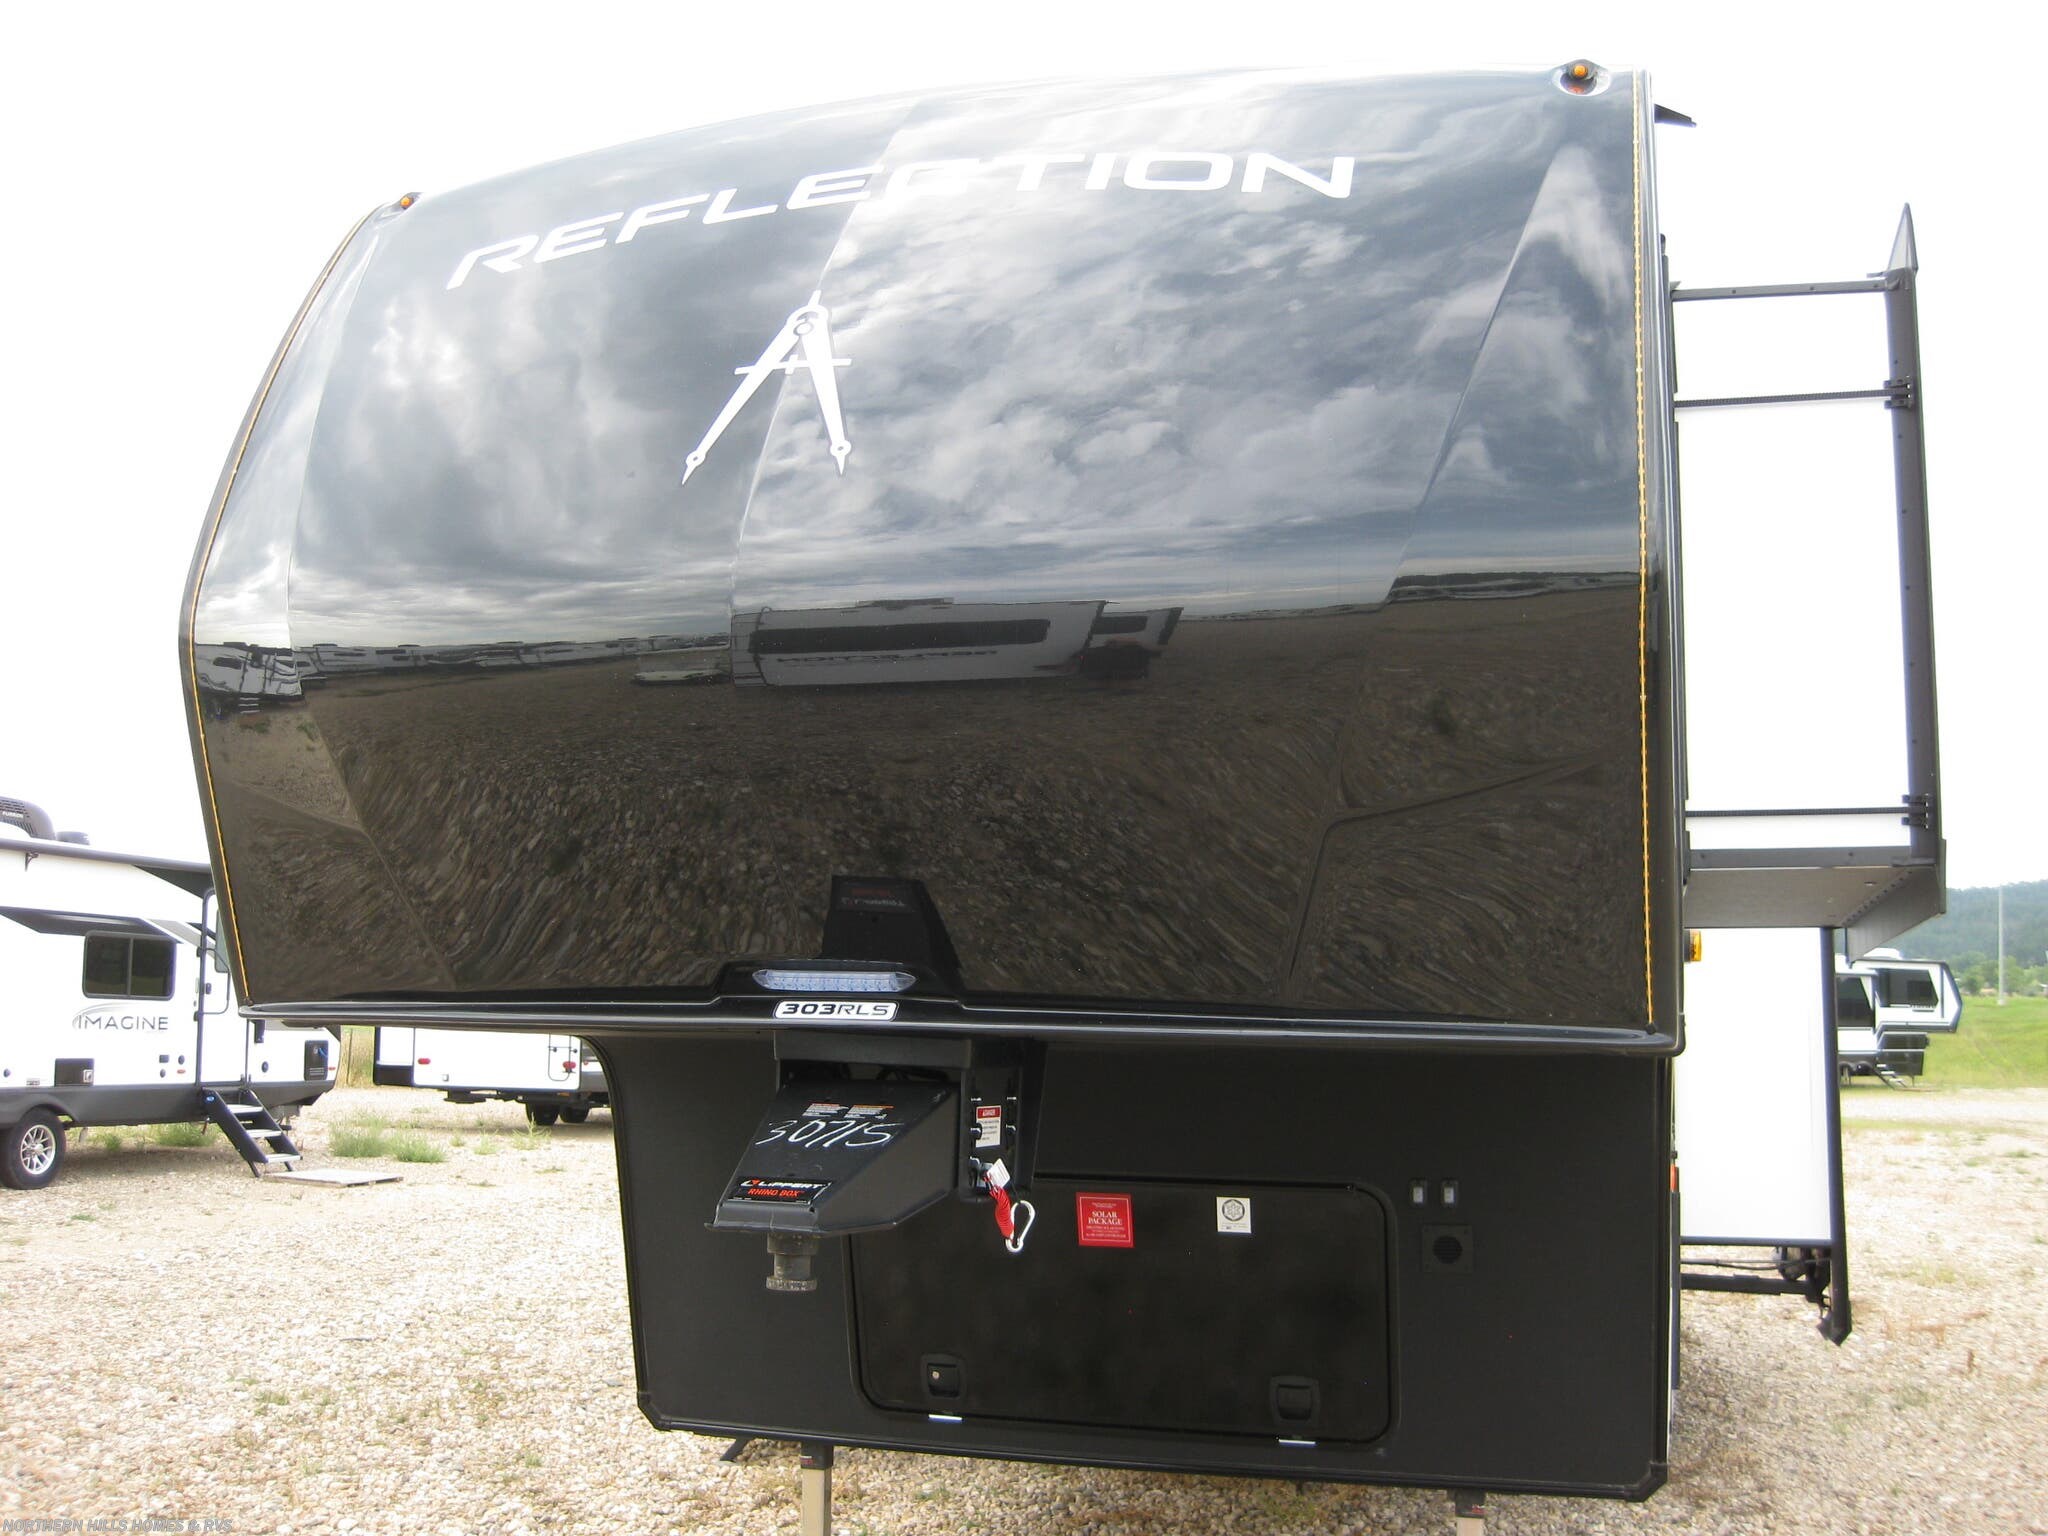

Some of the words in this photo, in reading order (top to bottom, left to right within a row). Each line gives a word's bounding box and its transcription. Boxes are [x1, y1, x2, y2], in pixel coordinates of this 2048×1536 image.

[447, 151, 1356, 289] REFLECTION
[780, 1001, 890, 1018] 303RLS
[78, 1015, 169, 1031] IMAGINE
[758, 1180, 823, 1189] LIPPERT
[747, 1188, 778, 1196] RHINO
[1091, 1210, 1118, 1218] SOLAR
[1088, 1217, 1123, 1226] PACKAGE
